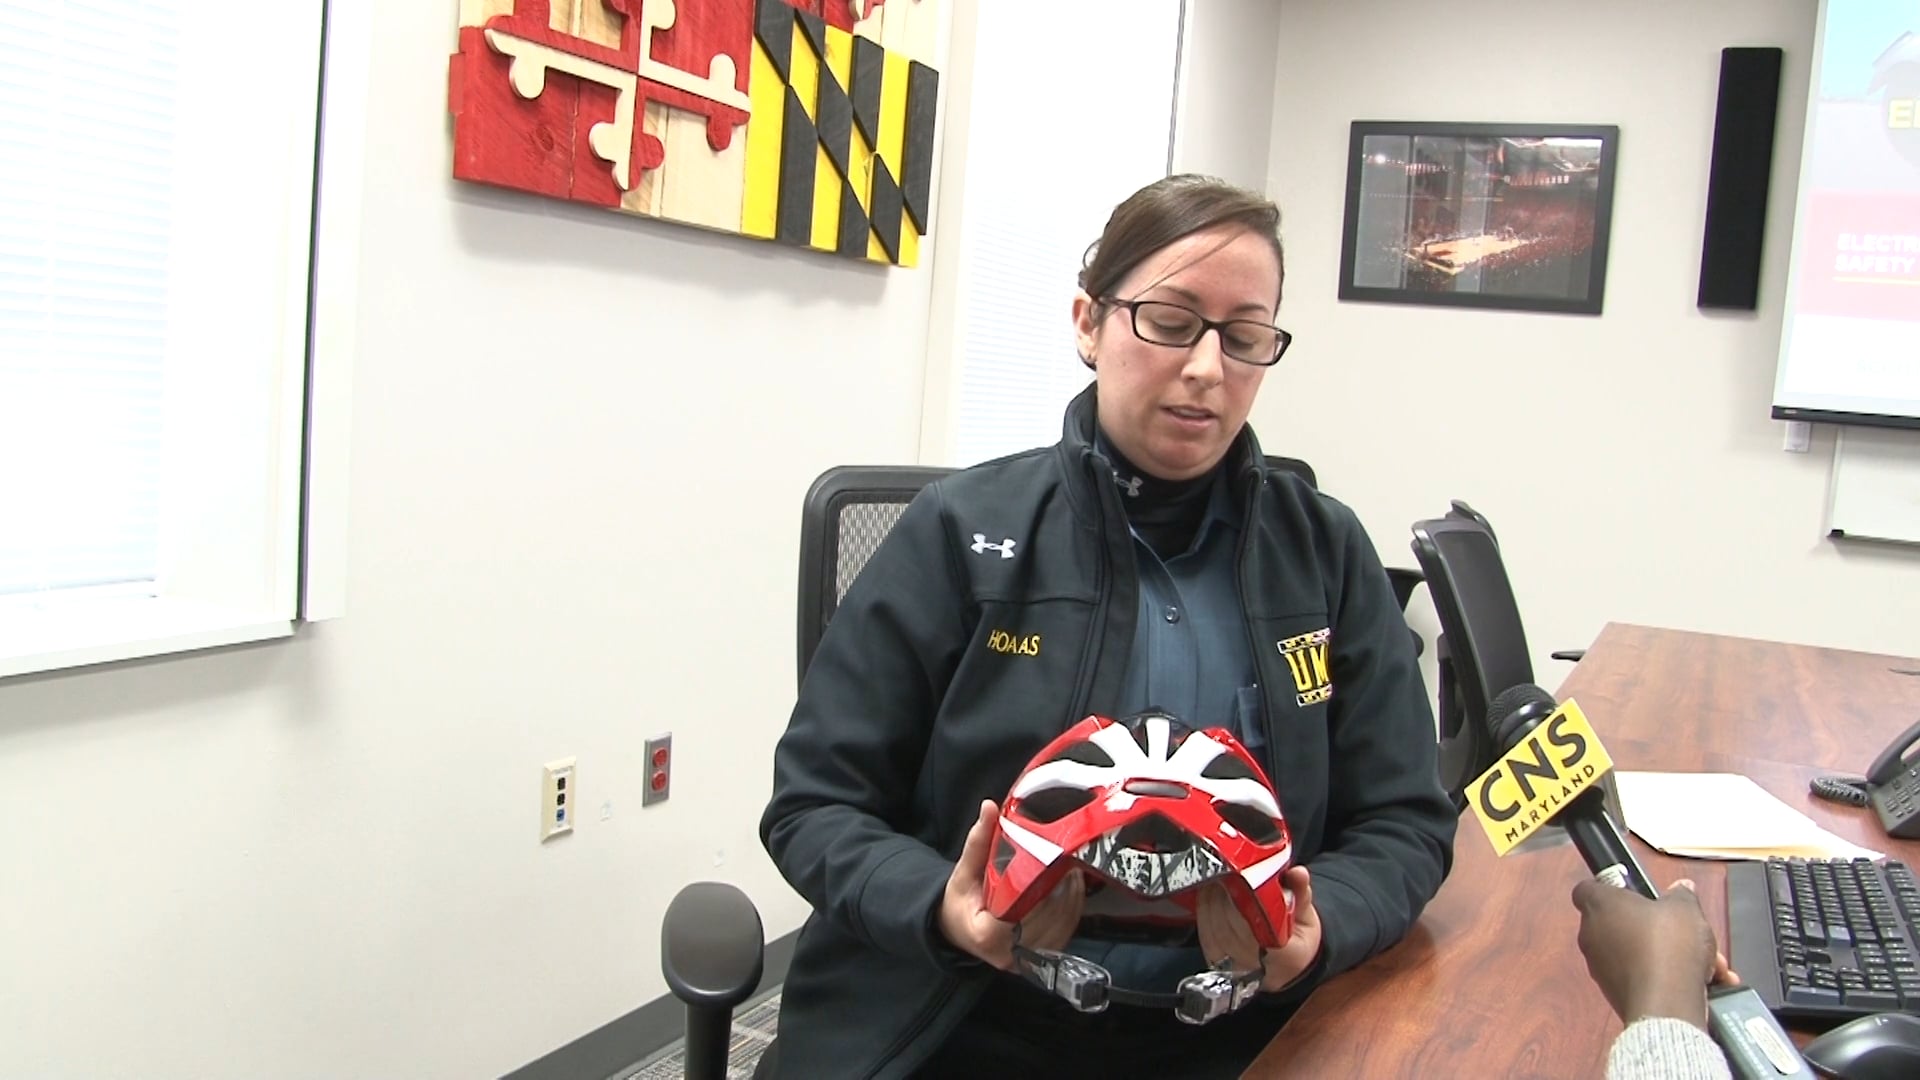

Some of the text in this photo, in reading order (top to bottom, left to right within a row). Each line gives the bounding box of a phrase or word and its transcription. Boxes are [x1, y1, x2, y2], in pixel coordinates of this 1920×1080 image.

[1837, 233, 1920, 253] ELECTR
[1834, 253, 1916, 273] SAFETY
[988, 630, 1041, 656] HOAAS
[1480, 713, 1587, 822] CNS
[1505, 765, 1595, 843] MARYLAND
